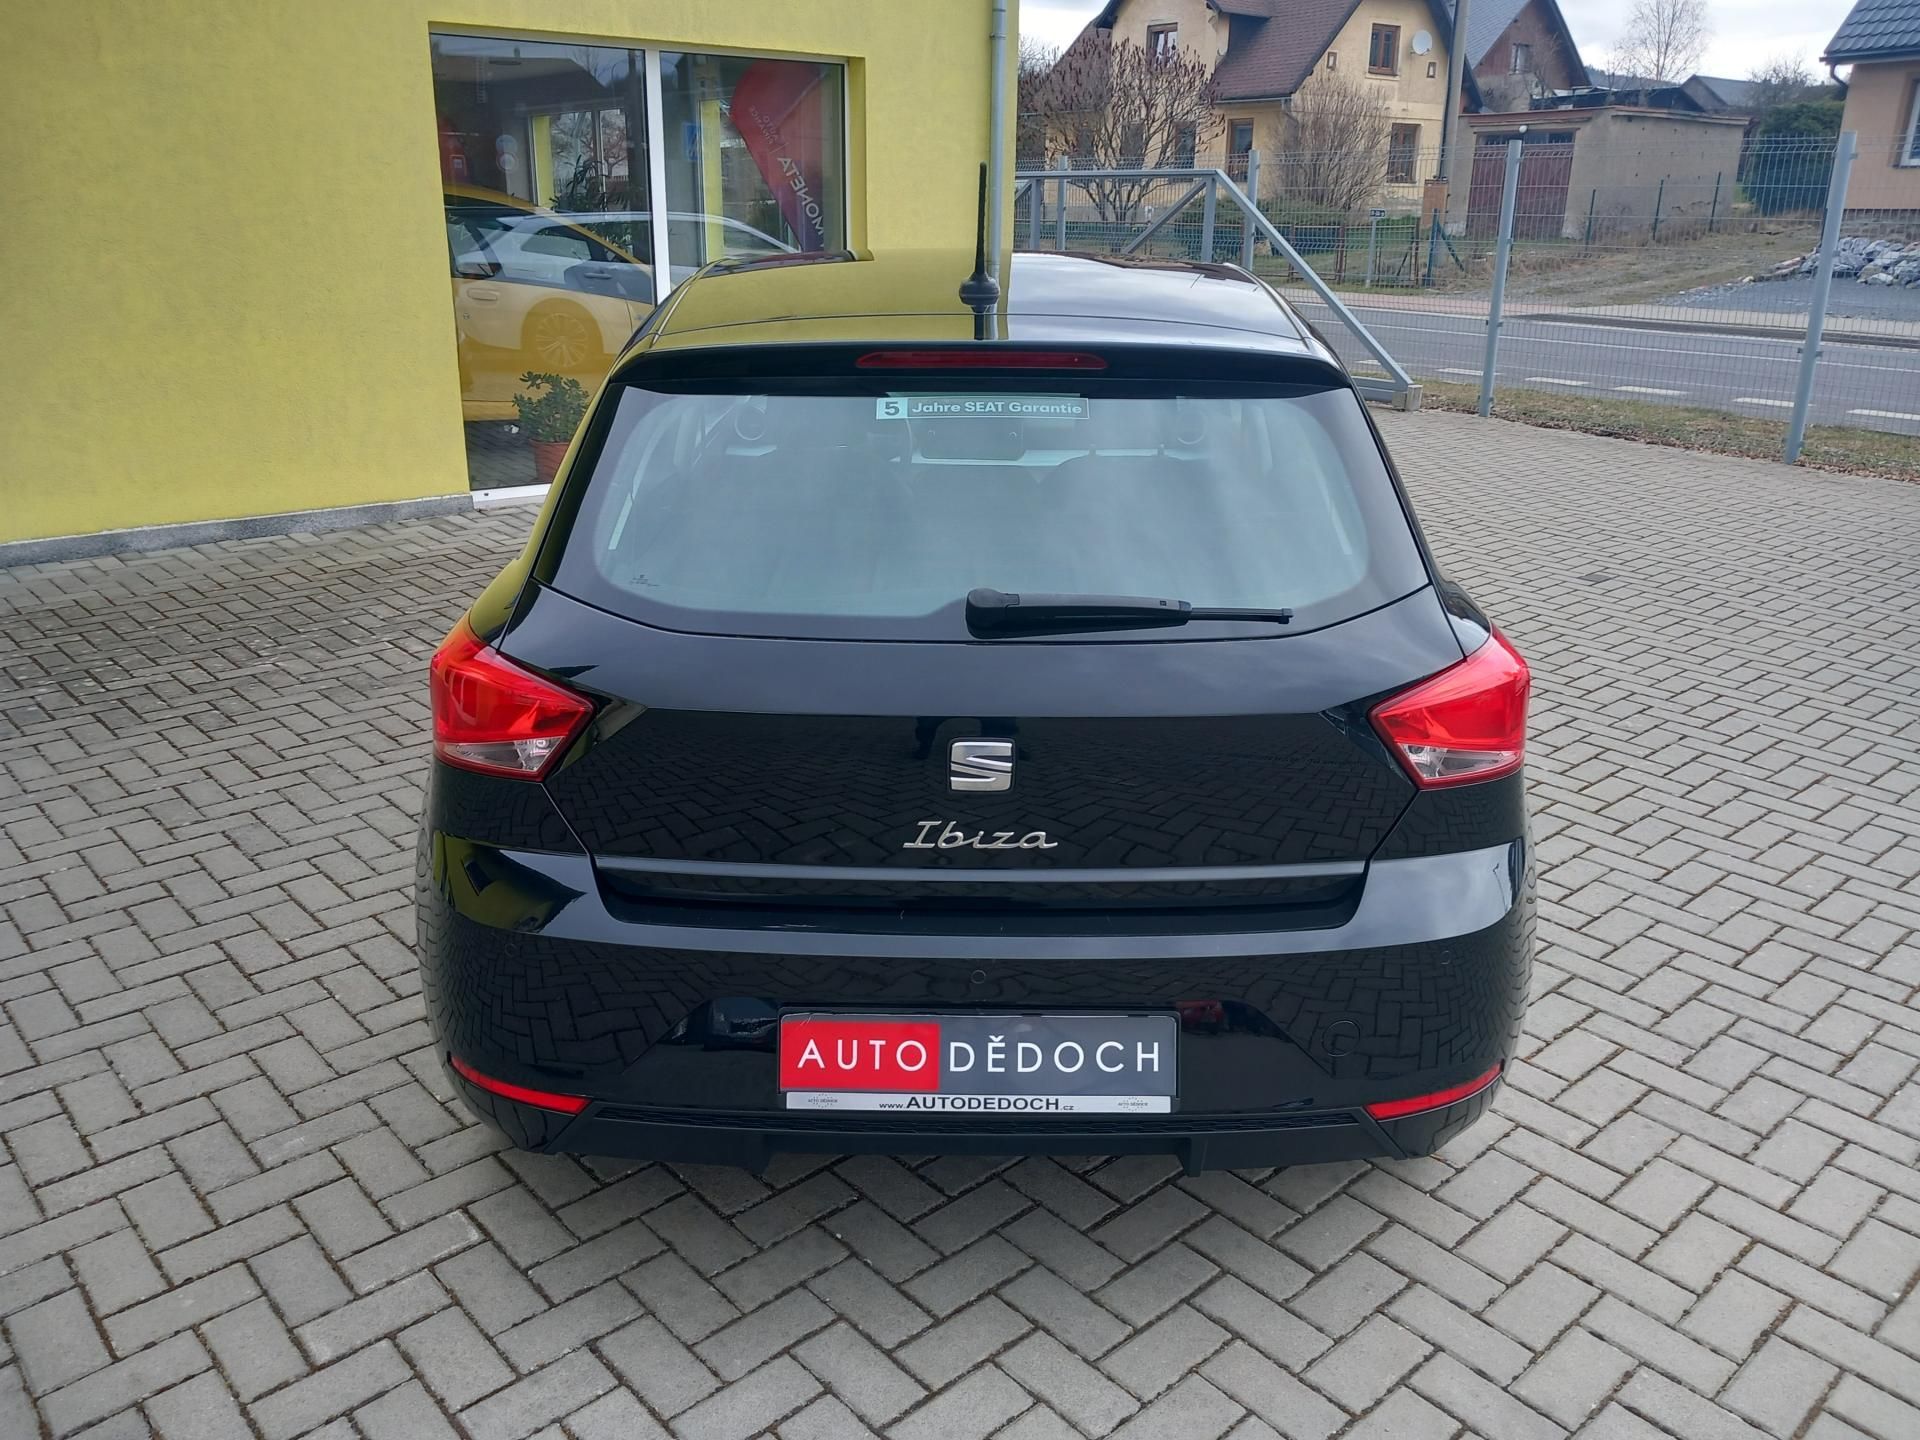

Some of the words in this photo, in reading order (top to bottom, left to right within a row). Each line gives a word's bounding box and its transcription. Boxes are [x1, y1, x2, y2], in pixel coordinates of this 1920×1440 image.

[884, 401, 900, 416] 5
[912, 402, 961, 413] Jahre
[965, 402, 1005, 413] SEAT
[1008, 402, 1083, 414] Garantie
[902, 820, 1058, 849] Ibiza
[797, 1038, 927, 1072] AUTO
[949, 1034, 1160, 1073] DĚDOCH
[879, 1096, 1074, 1112] www.AUTODEDOCH.cz
